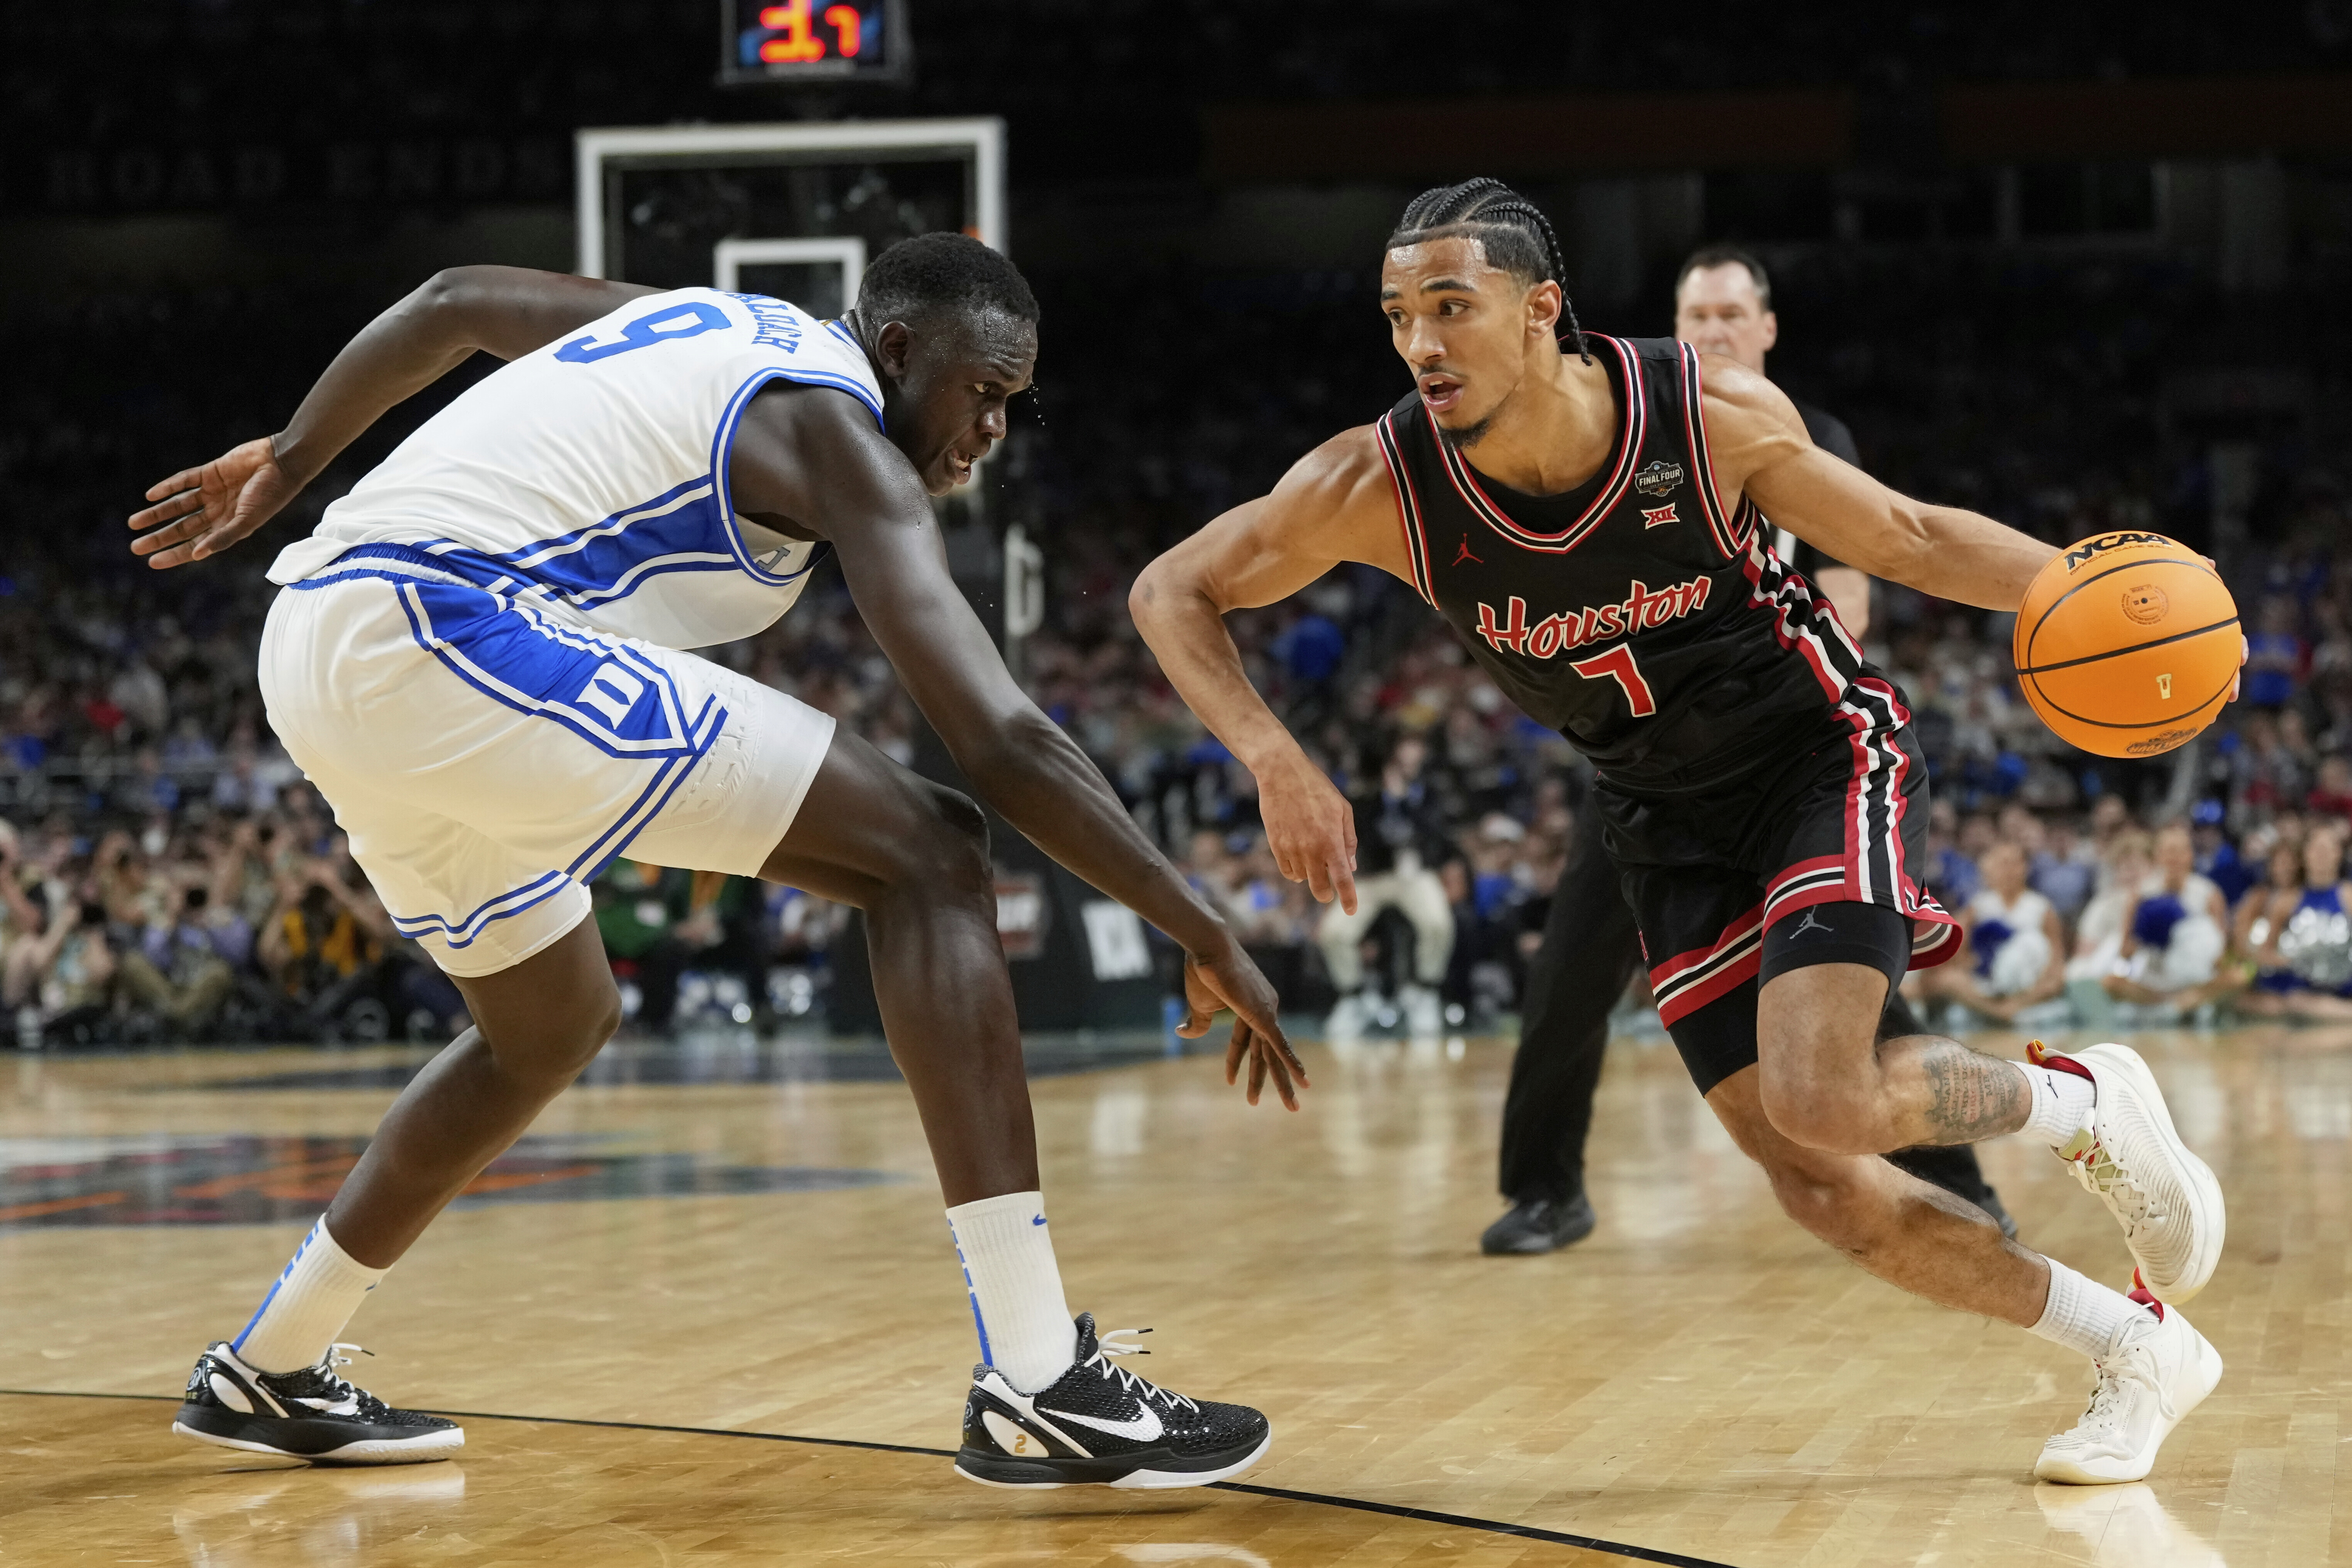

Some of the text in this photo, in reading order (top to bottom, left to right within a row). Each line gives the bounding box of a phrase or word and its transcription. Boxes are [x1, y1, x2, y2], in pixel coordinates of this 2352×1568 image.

[552, 302, 732, 364] 9
[1639, 474, 1660, 486] FINAL
[1661, 469, 1680, 481] FOUR
[1642, 504, 1679, 528] XII
[2064, 534, 2173, 570] NCAA
[2070, 552, 2113, 575] OFFICIAL
[1476, 575, 1712, 659] Houston
[1569, 642, 1657, 718] 7
[1014, 1434, 1027, 1453] 2
